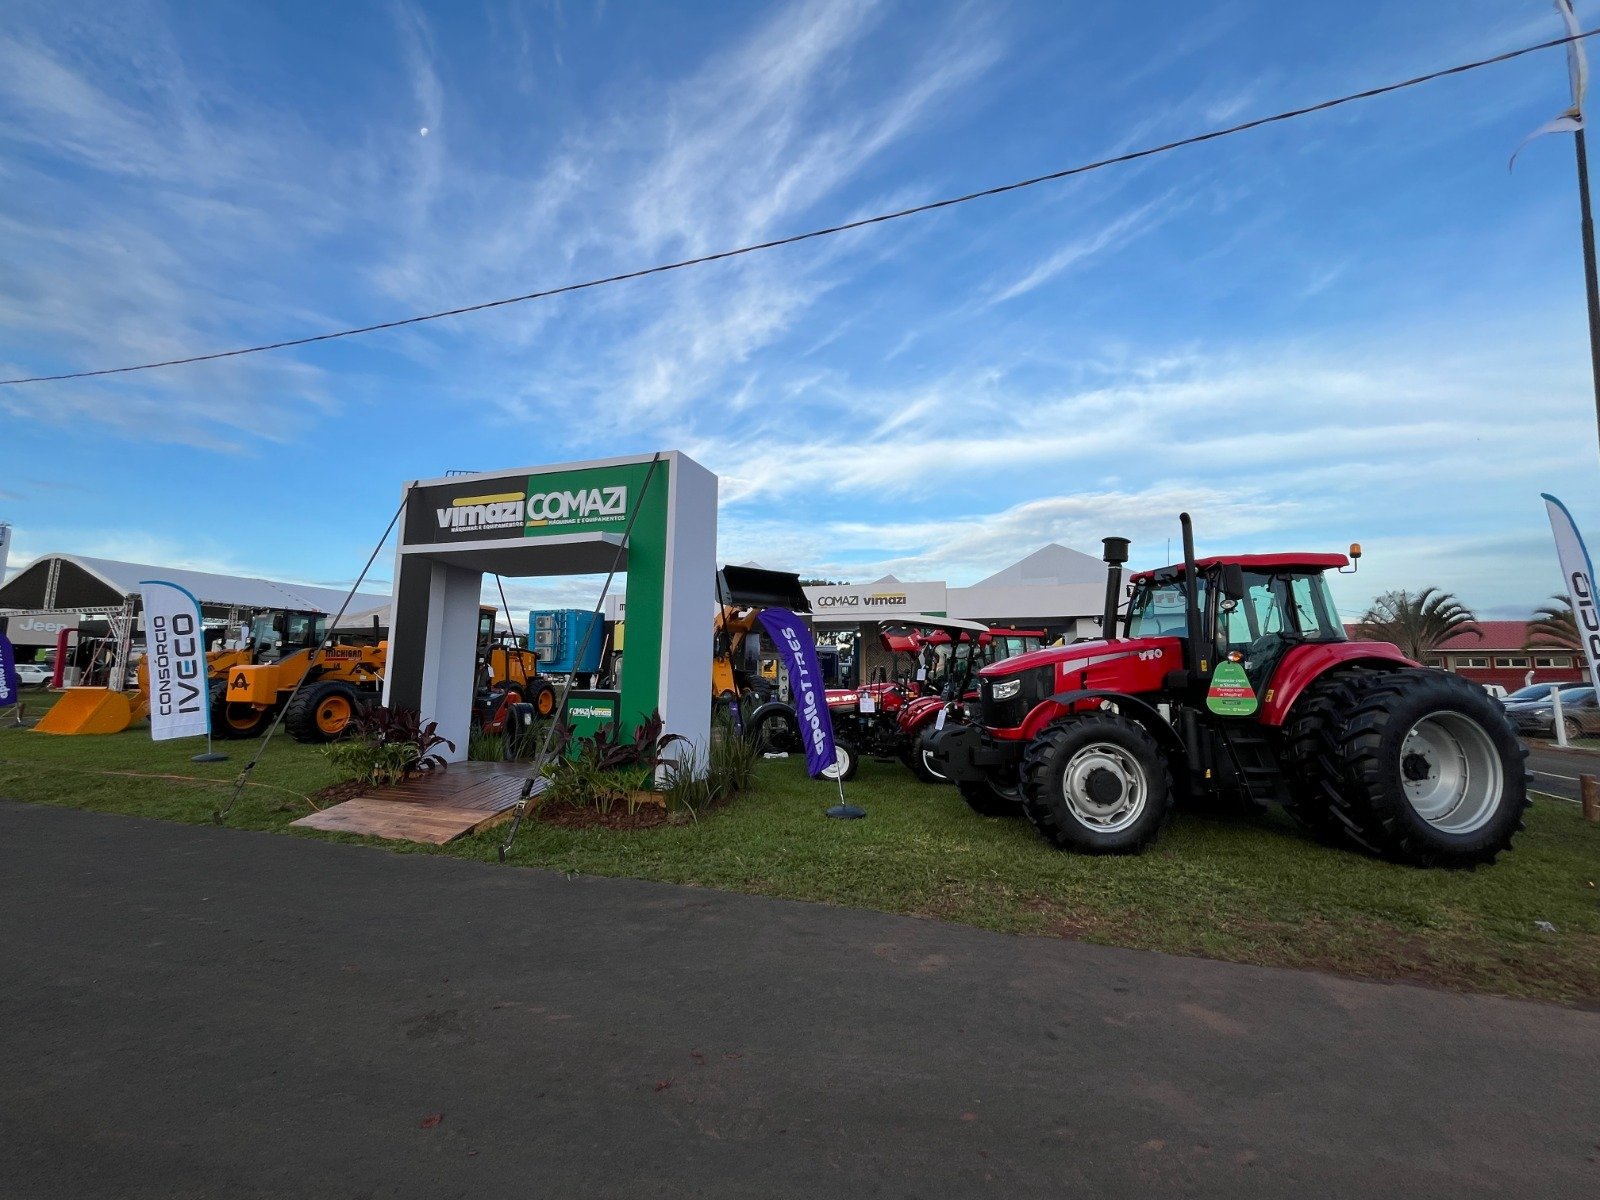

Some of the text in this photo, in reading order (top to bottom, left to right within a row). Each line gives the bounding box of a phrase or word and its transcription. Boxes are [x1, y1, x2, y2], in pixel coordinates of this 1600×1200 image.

[436, 500, 525, 529] vimazi
[526, 485, 627, 521] COMAZI
[581, 514, 626, 523] EQUIPAMENTOS
[817, 595, 907, 607] COMAZI vimazi
[19, 618, 68, 634] Jeep
[153, 615, 172, 716] CONSÓRCIO
[172, 613, 200, 714] IVECO
[781, 627, 813, 692] TYRES
[1138, 648, 1163, 661] YTO
[803, 691, 826, 756] apollo
